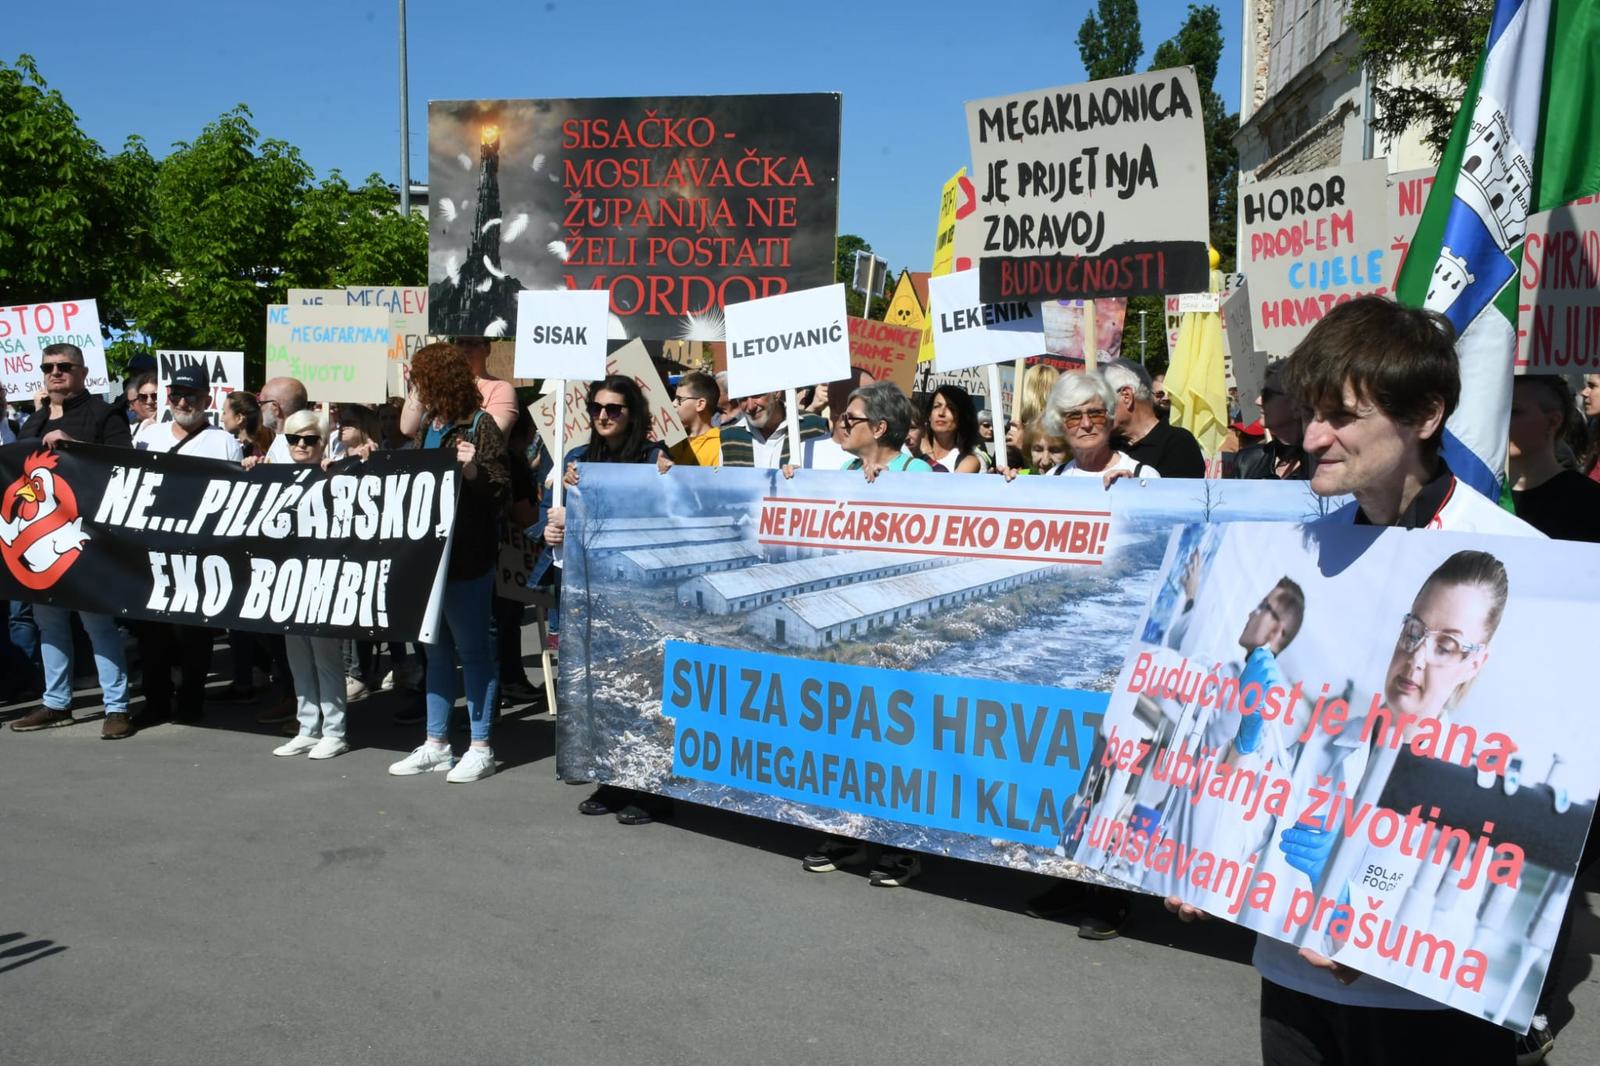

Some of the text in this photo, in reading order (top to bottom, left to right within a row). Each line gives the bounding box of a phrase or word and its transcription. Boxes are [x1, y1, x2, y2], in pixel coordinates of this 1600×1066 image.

[562, 109, 716, 149] SISAČKO
[979, 77, 1193, 143] MEGAKLAONICA
[563, 148, 815, 188] MOSLAVAČKA
[981, 159, 1010, 203] JE
[563, 190, 798, 233] ŽUPANIJA NE
[1244, 175, 1345, 225] HOROR
[562, 229, 793, 267] ŽELI POSTATI
[983, 210, 1105, 253] ZDRAVOJ
[1251, 209, 1354, 262] PROBLEM
[1288, 248, 1384, 290] CIJELE
[0, 303, 79, 337] STOP
[269, 307, 290, 325] NE
[940, 301, 1033, 333] LEKENIK
[1262, 287, 1387, 329] HRVAT
[37, 333, 95, 350] PRIRODA
[267, 343, 289, 363] DA
[533, 325, 587, 346] SISAK
[733, 321, 842, 359] LETOVANIĆ
[849, 341, 895, 363] FARME
[1514, 304, 1600, 367] ENJU!
[4, 354, 33, 375] NAS
[289, 356, 356, 383] ŽIVOTU
[25, 381, 42, 392] SMR
[759, 503, 1110, 555] NE PILIĆARSKOJ EKO BOMBI!
[146, 551, 392, 628] EKO BOMBI!
[671, 658, 727, 716] SVI
[740, 669, 788, 727] ZA
[800, 677, 915, 746] SPAS
[1127, 652, 1515, 776] Budućnost je hrana
[679, 727, 1077, 836] OD MEGAFARMI I KLA
[1101, 725, 1525, 890] bez ubijanja životinja
[1073, 799, 1489, 993] i uništavanja prašuma
